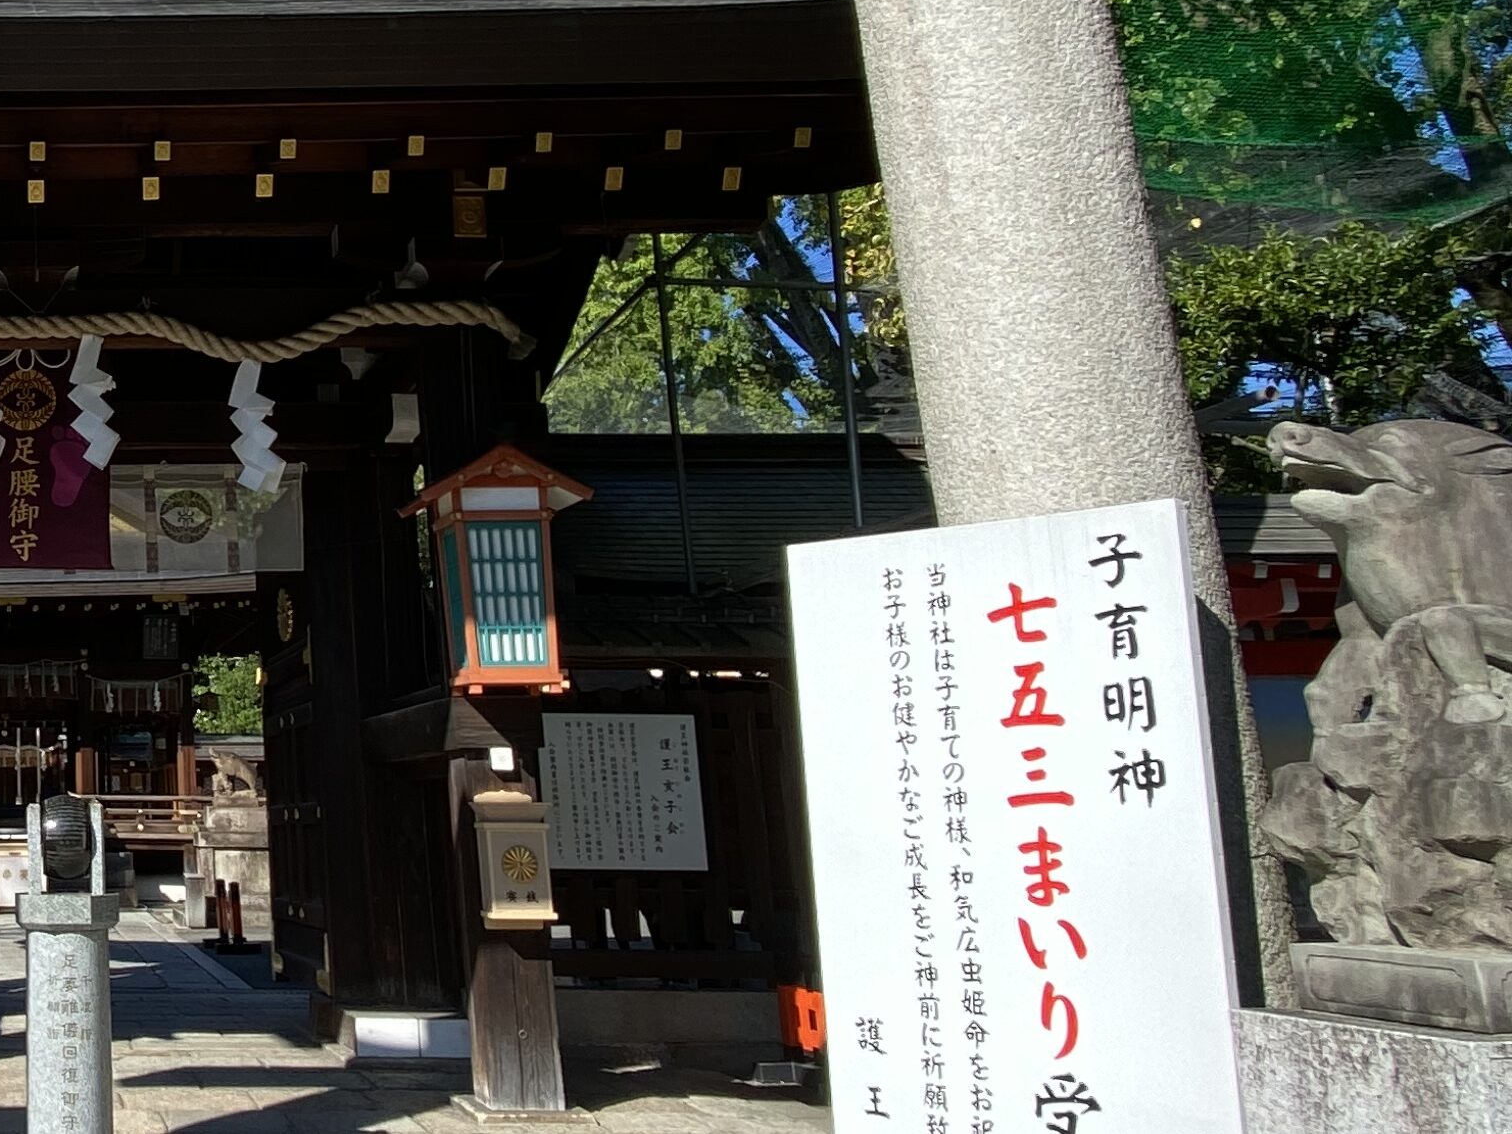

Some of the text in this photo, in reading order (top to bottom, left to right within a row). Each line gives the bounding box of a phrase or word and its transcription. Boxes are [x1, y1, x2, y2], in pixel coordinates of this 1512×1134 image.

[7, 435, 41, 562] 足腰御守
[1087, 534, 1167, 809] 子育明神
